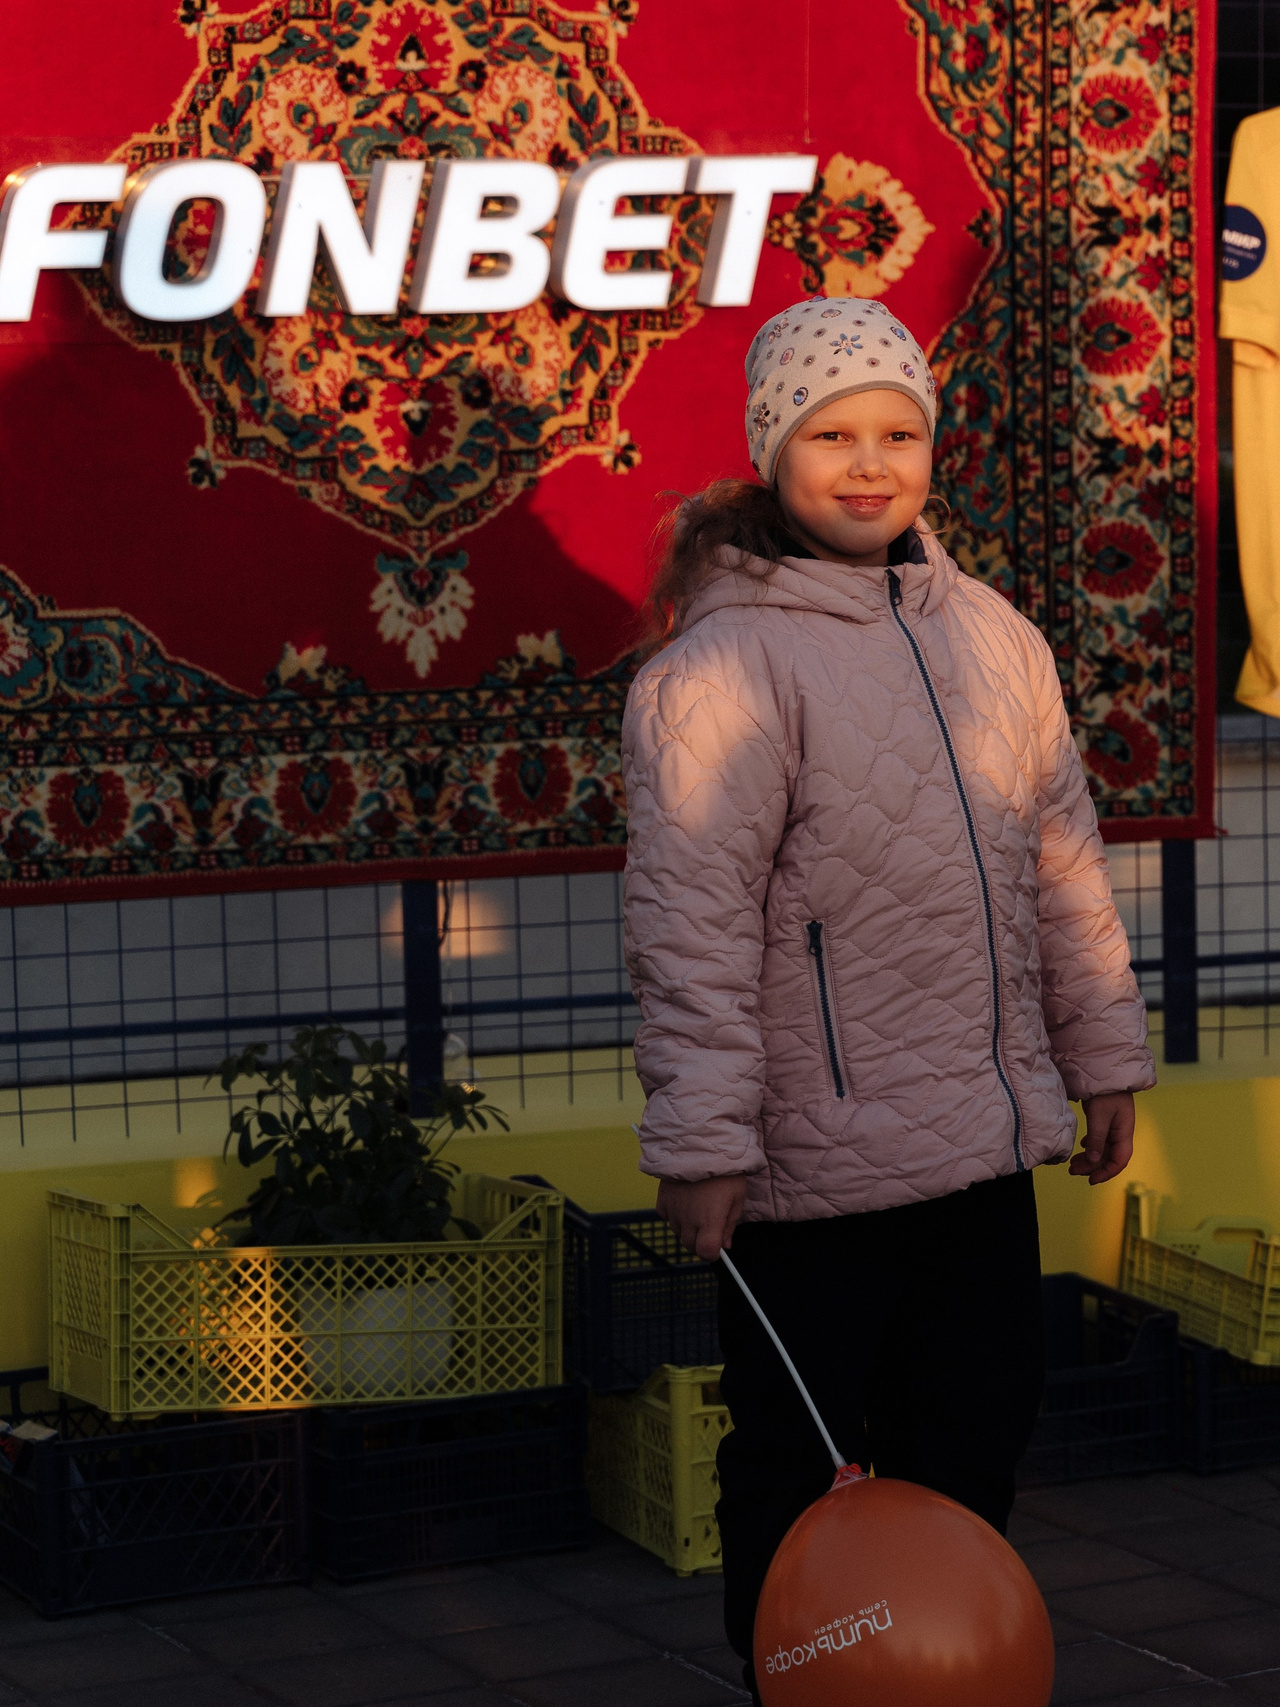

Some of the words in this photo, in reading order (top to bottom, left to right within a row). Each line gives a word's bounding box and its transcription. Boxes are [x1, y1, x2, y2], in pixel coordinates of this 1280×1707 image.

[0, 154, 819, 323] FONBET
[858, 1599, 888, 1616] сеть
[814, 1613, 855, 1636] кофеен
